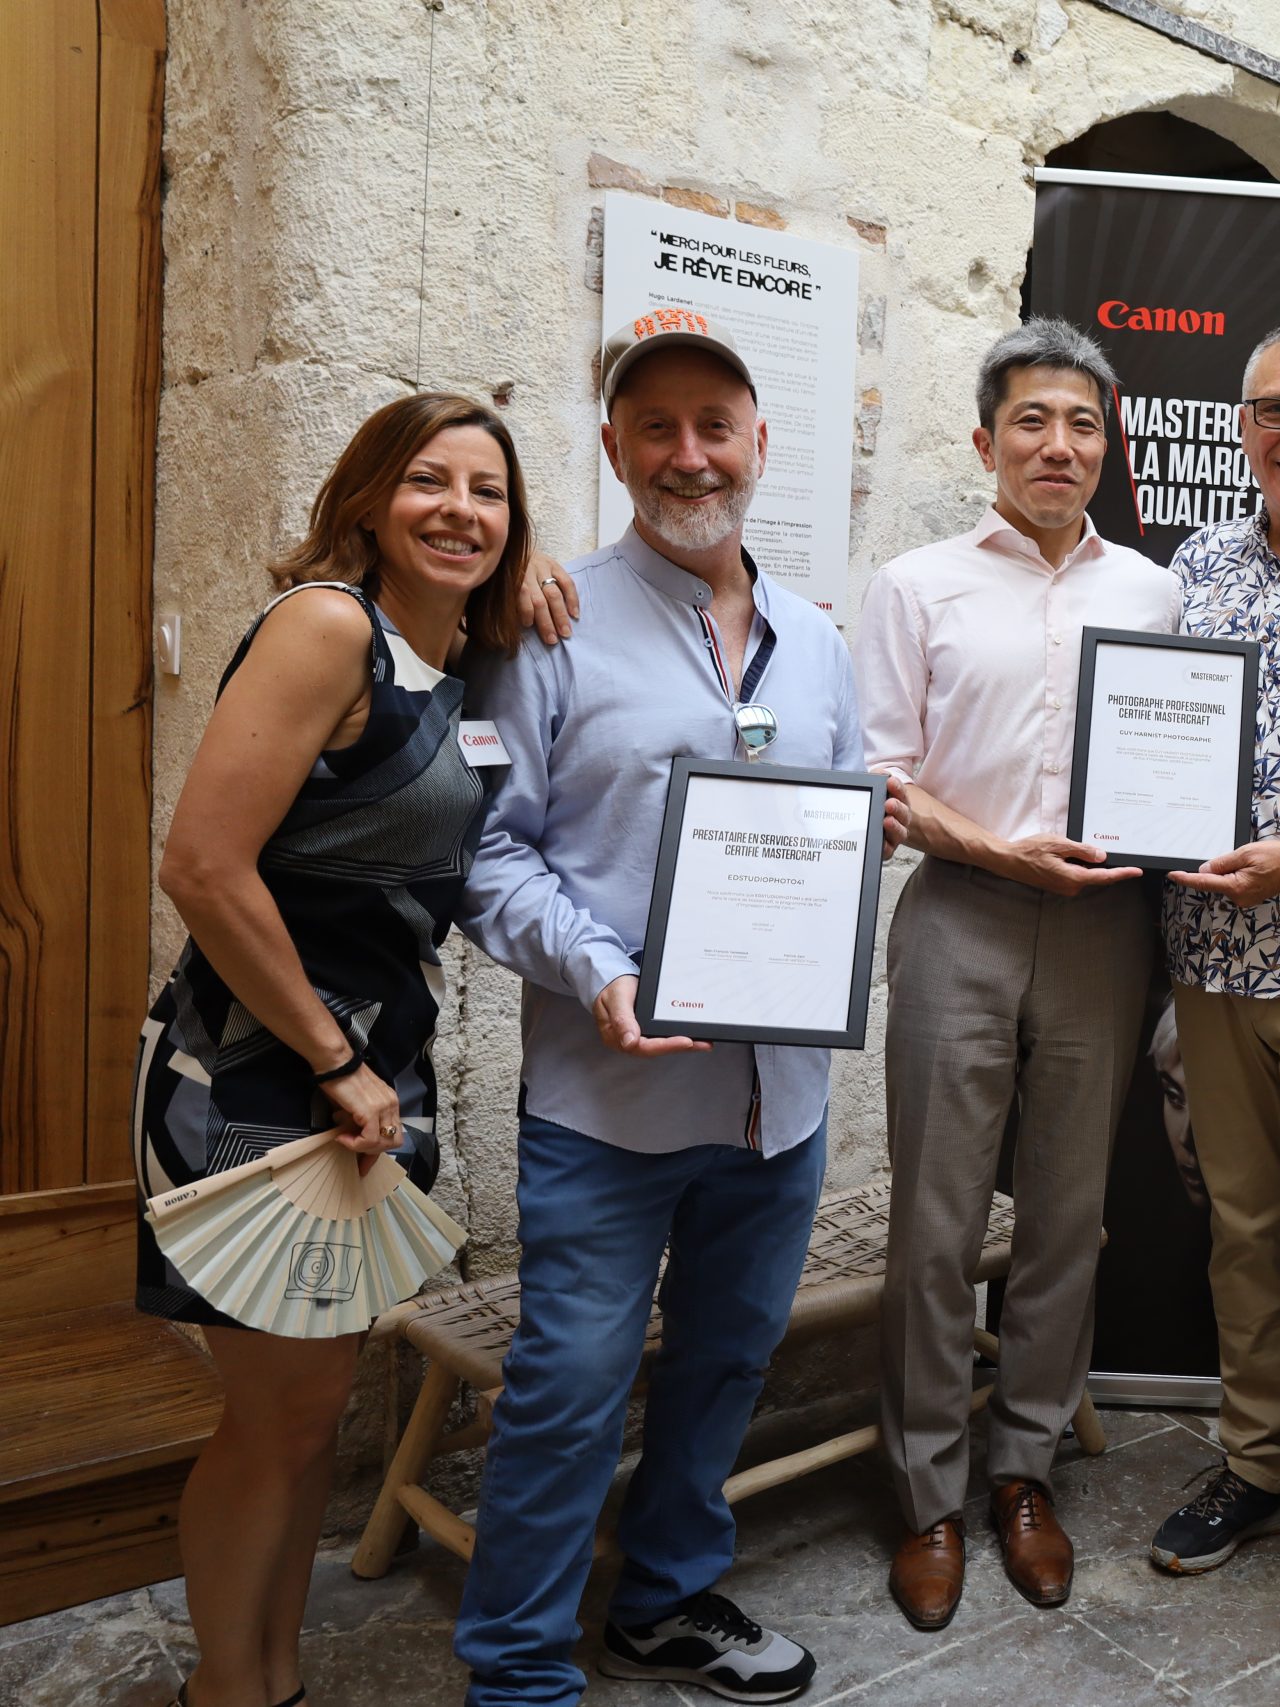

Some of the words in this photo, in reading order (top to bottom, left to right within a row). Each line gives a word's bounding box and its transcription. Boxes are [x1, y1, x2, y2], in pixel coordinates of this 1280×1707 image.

[654, 252, 677, 272] JE
[683, 257, 732, 283] RÊVE
[703, 242, 736, 259] POUR
[739, 250, 761, 265] LES
[764, 256, 811, 277] FLEURS,
[1097, 300, 1226, 336] Canon
[1121, 396, 1244, 443] MASTERC
[1129, 440, 1160, 481] LA
[1168, 442, 1260, 488] MARQ
[1137, 484, 1248, 528] QUALITÉ
[1190, 672, 1229, 683] MASTERCRAFT
[1108, 694, 1164, 709] PHOTOGRAPHE
[1165, 699, 1226, 715] PROFESSIONNEL
[1118, 707, 1151, 720] CERTIFIÉ
[1154, 711, 1210, 726] MASTERCRAFT
[463, 734, 499, 746] Canon
[1163, 733, 1212, 743] PHOTOGRAPHE
[692, 828, 747, 844] PRESTATAIRE
[748, 833, 759, 844] EN
[760, 834, 799, 847] SERVICES
[1093, 833, 1120, 841] Canon
[762, 847, 822, 862] MASTERCRAFT
[670, 999, 704, 1009] Canon
[164, 1190, 198, 1207] Canon
